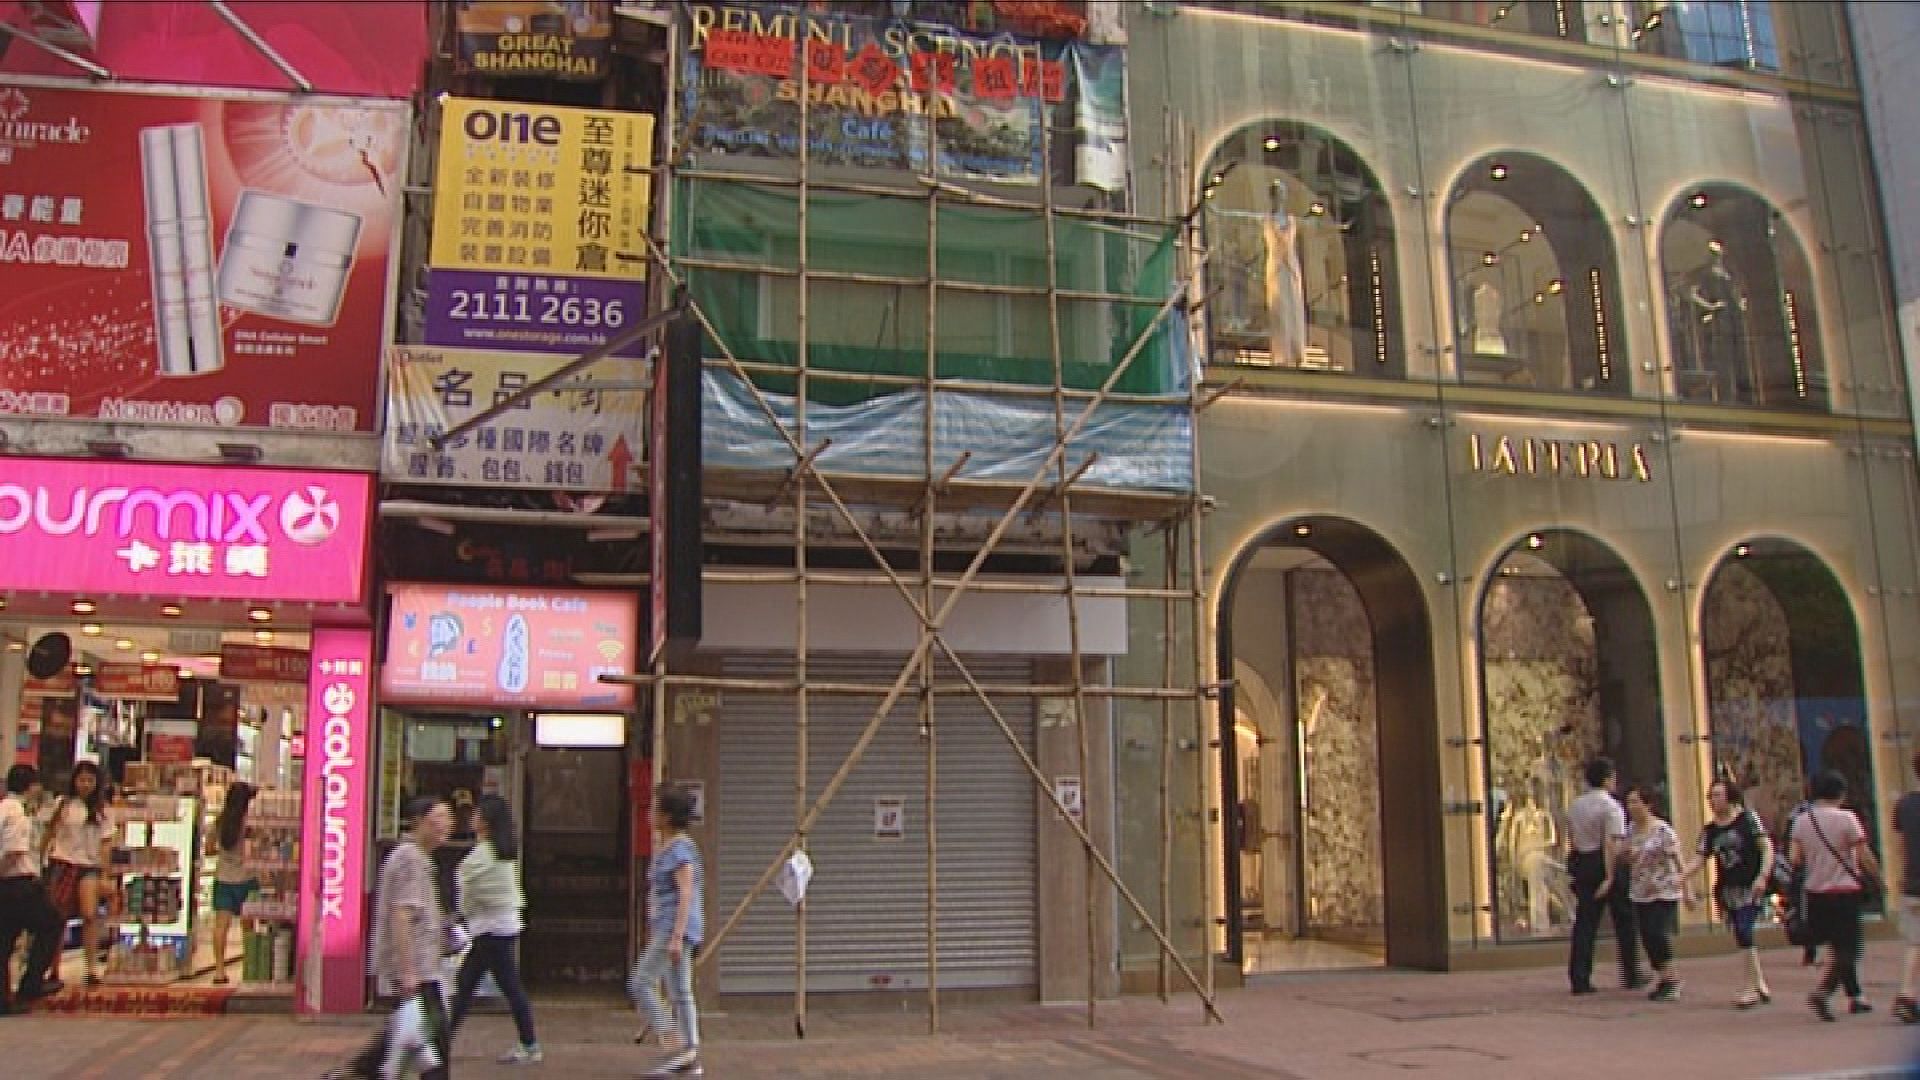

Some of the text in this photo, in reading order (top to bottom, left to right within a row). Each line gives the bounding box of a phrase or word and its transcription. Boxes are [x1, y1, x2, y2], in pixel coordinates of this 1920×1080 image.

[499, 33, 574, 54] GREAT
[474, 52, 597, 74] SHANGHAI
[463, 109, 561, 146] one
[576, 116, 614, 272] 至尊迷你倉
[450, 289, 624, 328] 2111 2636
[321, 717, 356, 919] colourmix
